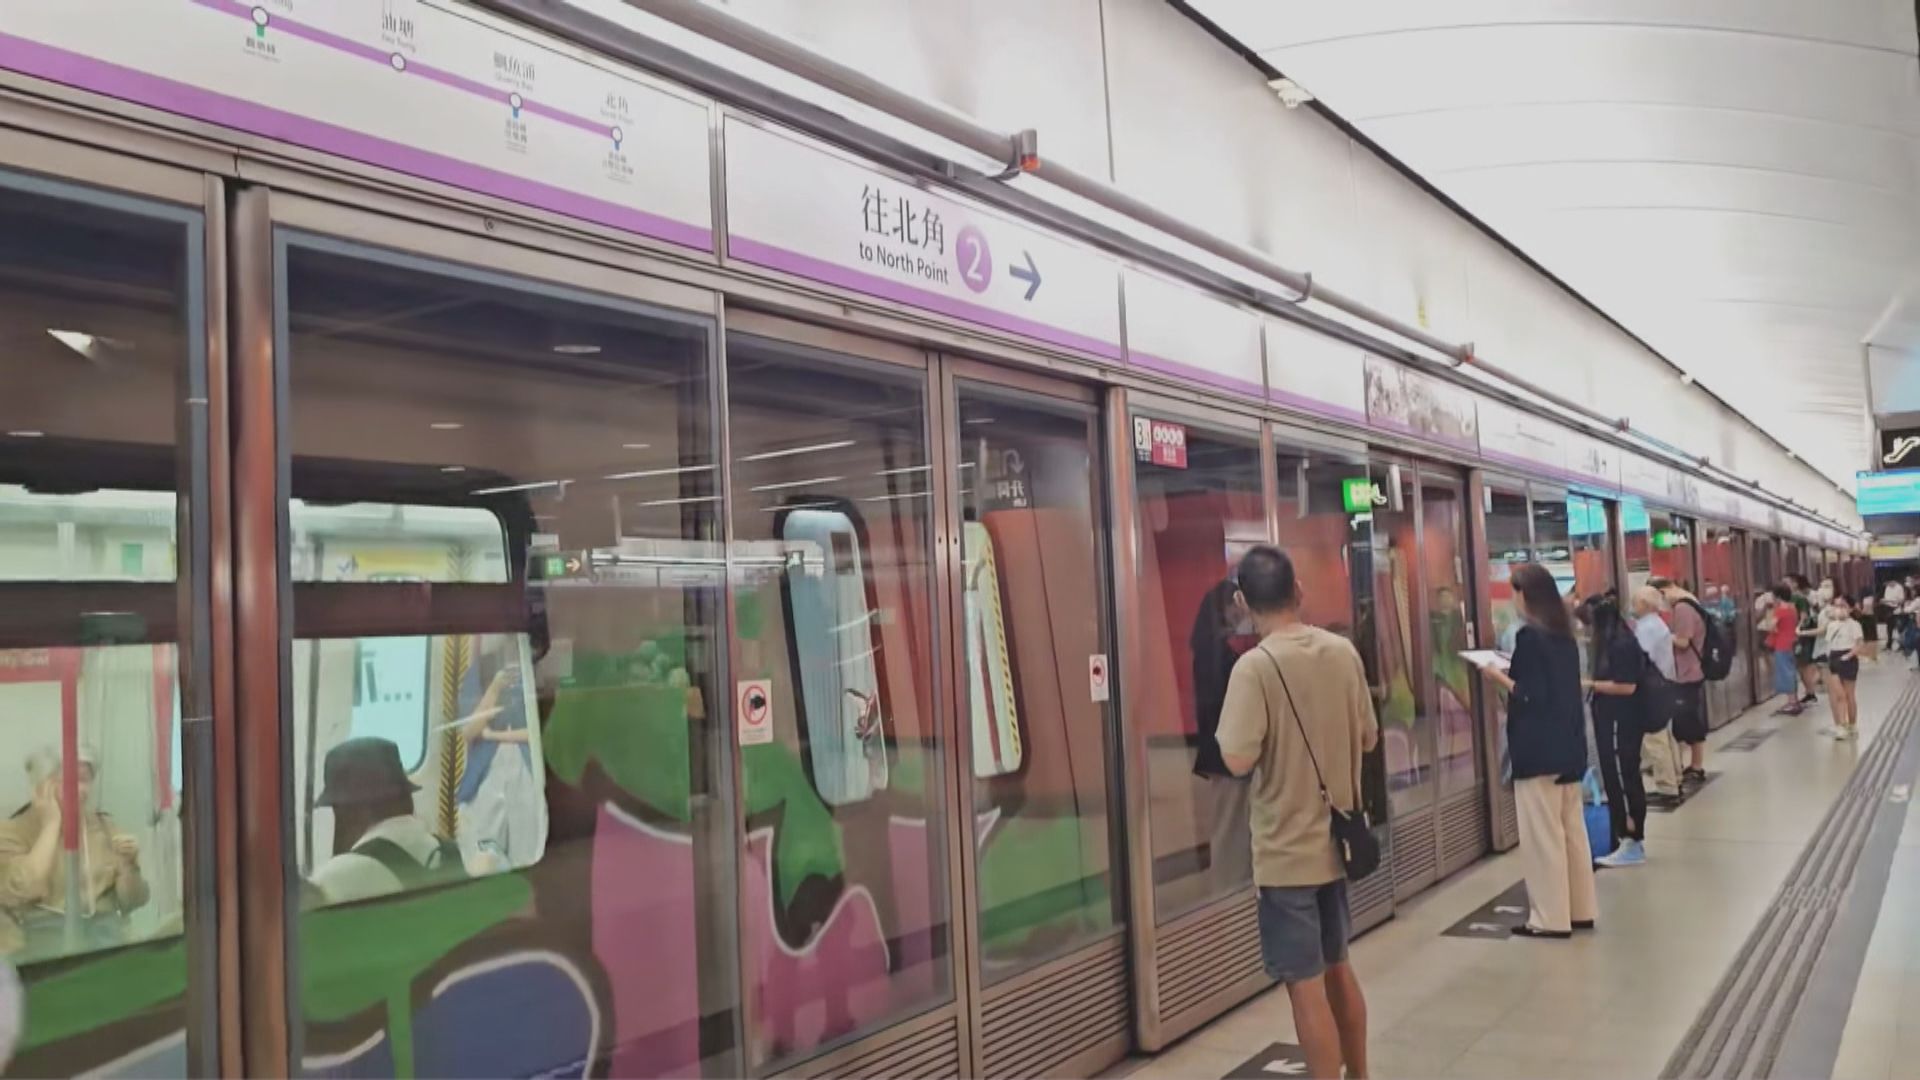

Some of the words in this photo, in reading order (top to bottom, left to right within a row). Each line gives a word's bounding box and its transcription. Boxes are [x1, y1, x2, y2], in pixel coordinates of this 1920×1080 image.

[861, 184, 944, 256] 往北角
[859, 241, 873, 262] to
[877, 244, 914, 274] North
[917, 257, 949, 285] Point
[966, 235, 984, 282] 2
